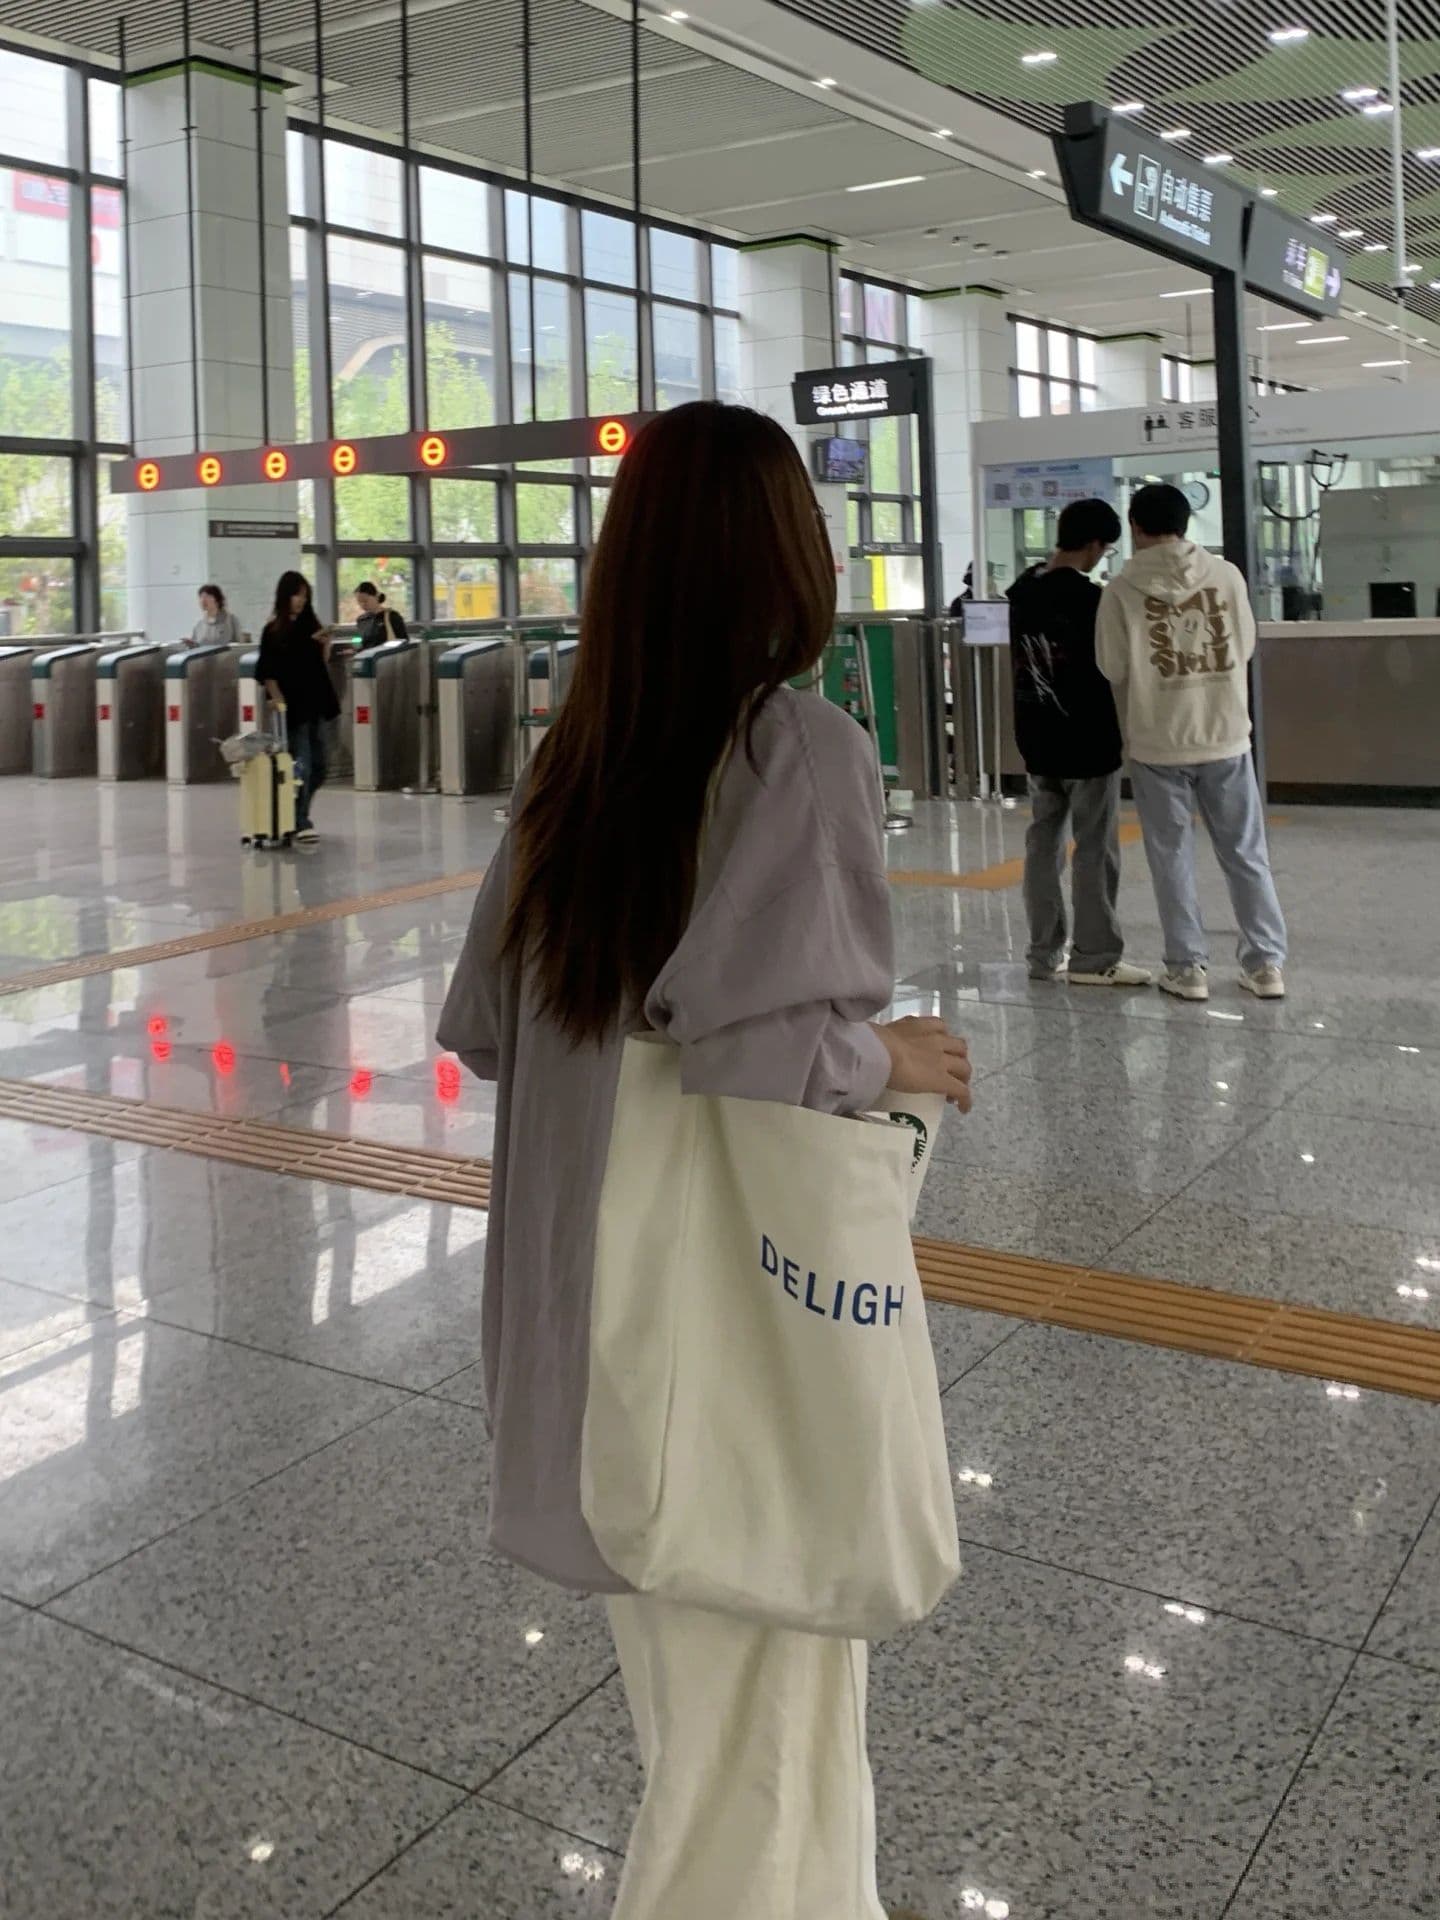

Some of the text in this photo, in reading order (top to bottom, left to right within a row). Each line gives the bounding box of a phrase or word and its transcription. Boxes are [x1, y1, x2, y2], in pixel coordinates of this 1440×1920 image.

[1160, 169, 1214, 222] 自动售票
[811, 379, 889, 404] 绿色通道
